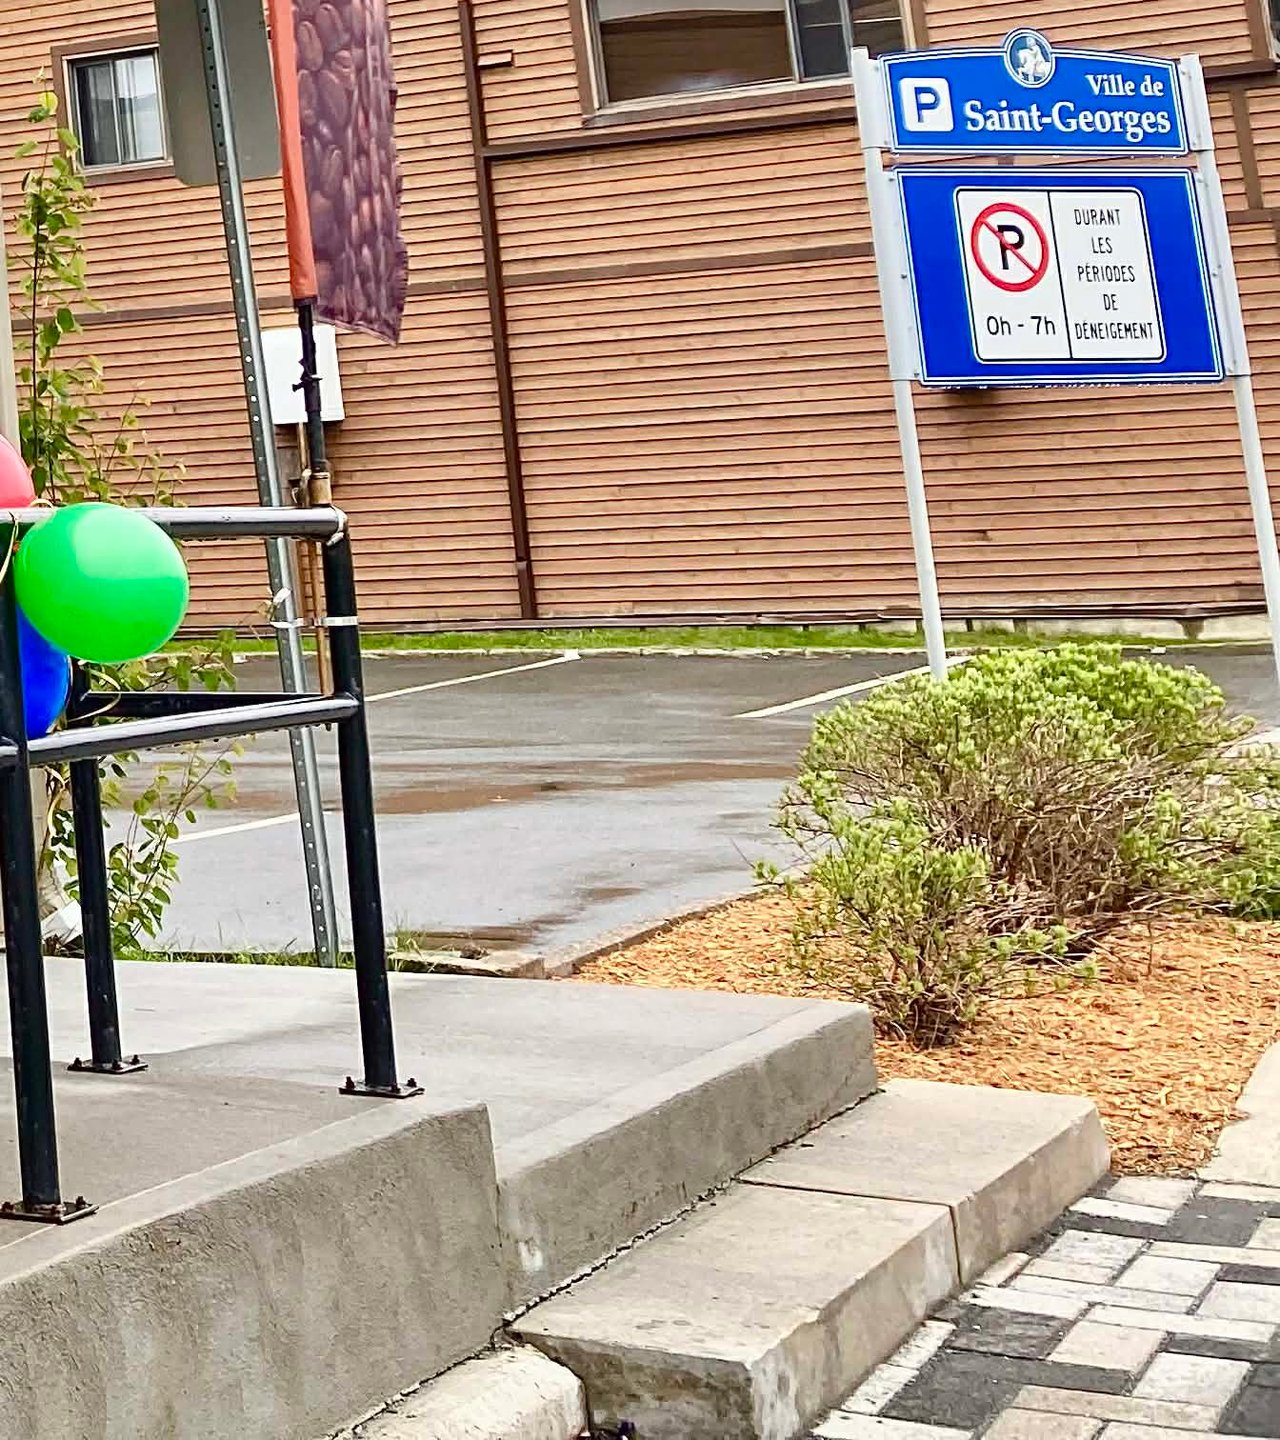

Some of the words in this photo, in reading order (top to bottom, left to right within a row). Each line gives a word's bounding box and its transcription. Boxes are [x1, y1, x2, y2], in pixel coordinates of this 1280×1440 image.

[1085, 74, 1136, 97] Ville
[1140, 75, 1164, 97] de
[965, 98, 1172, 142] Saint-Georges
[1074, 208, 1121, 226] DURANT
[1091, 236, 1113, 254] LES
[1077, 263, 1136, 283] PÉRIODES
[1103, 293, 1119, 311] DE
[1030, 315, 1056, 336] 7h
[1074, 320, 1154, 340] DÉNEIGEMENT
